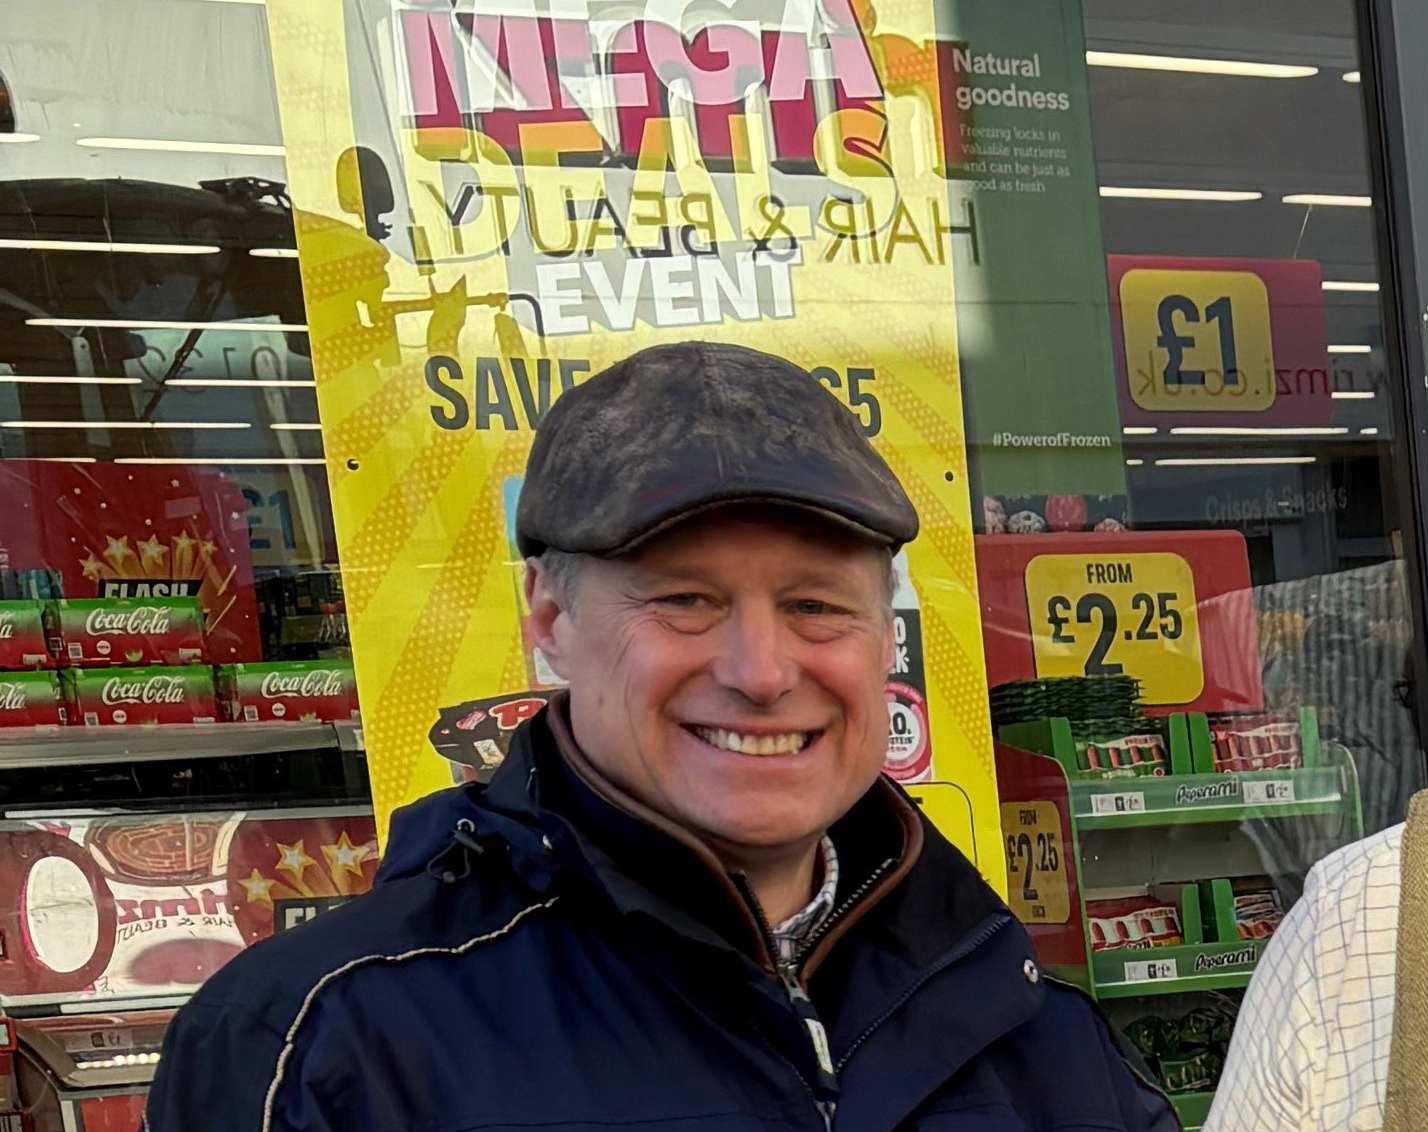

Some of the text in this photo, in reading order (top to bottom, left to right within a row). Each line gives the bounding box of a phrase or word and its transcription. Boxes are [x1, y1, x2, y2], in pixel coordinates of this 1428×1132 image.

[401, 0, 884, 116] MEGA
[953, 49, 1040, 77] Natural
[956, 83, 1070, 110] goodness
[1013, 127, 1045, 141] locks
[1013, 146, 1067, 160] nutrients
[401, 102, 899, 258] DEALS
[1015, 162, 1030, 175] be
[535, 254, 801, 334] EVENT
[1156, 294, 1239, 385] £1
[993, 431, 1112, 447] #PowerofFrozen
[1086, 563, 1133, 584] FROM
[85, 606, 171, 636] Coca-Cola
[1047, 592, 1183, 677] £2.25
[101, 675, 185, 706] Coca-Cola
[261, 668, 342, 699] Coca-Cola
[1007, 832, 1059, 900] £2.25
